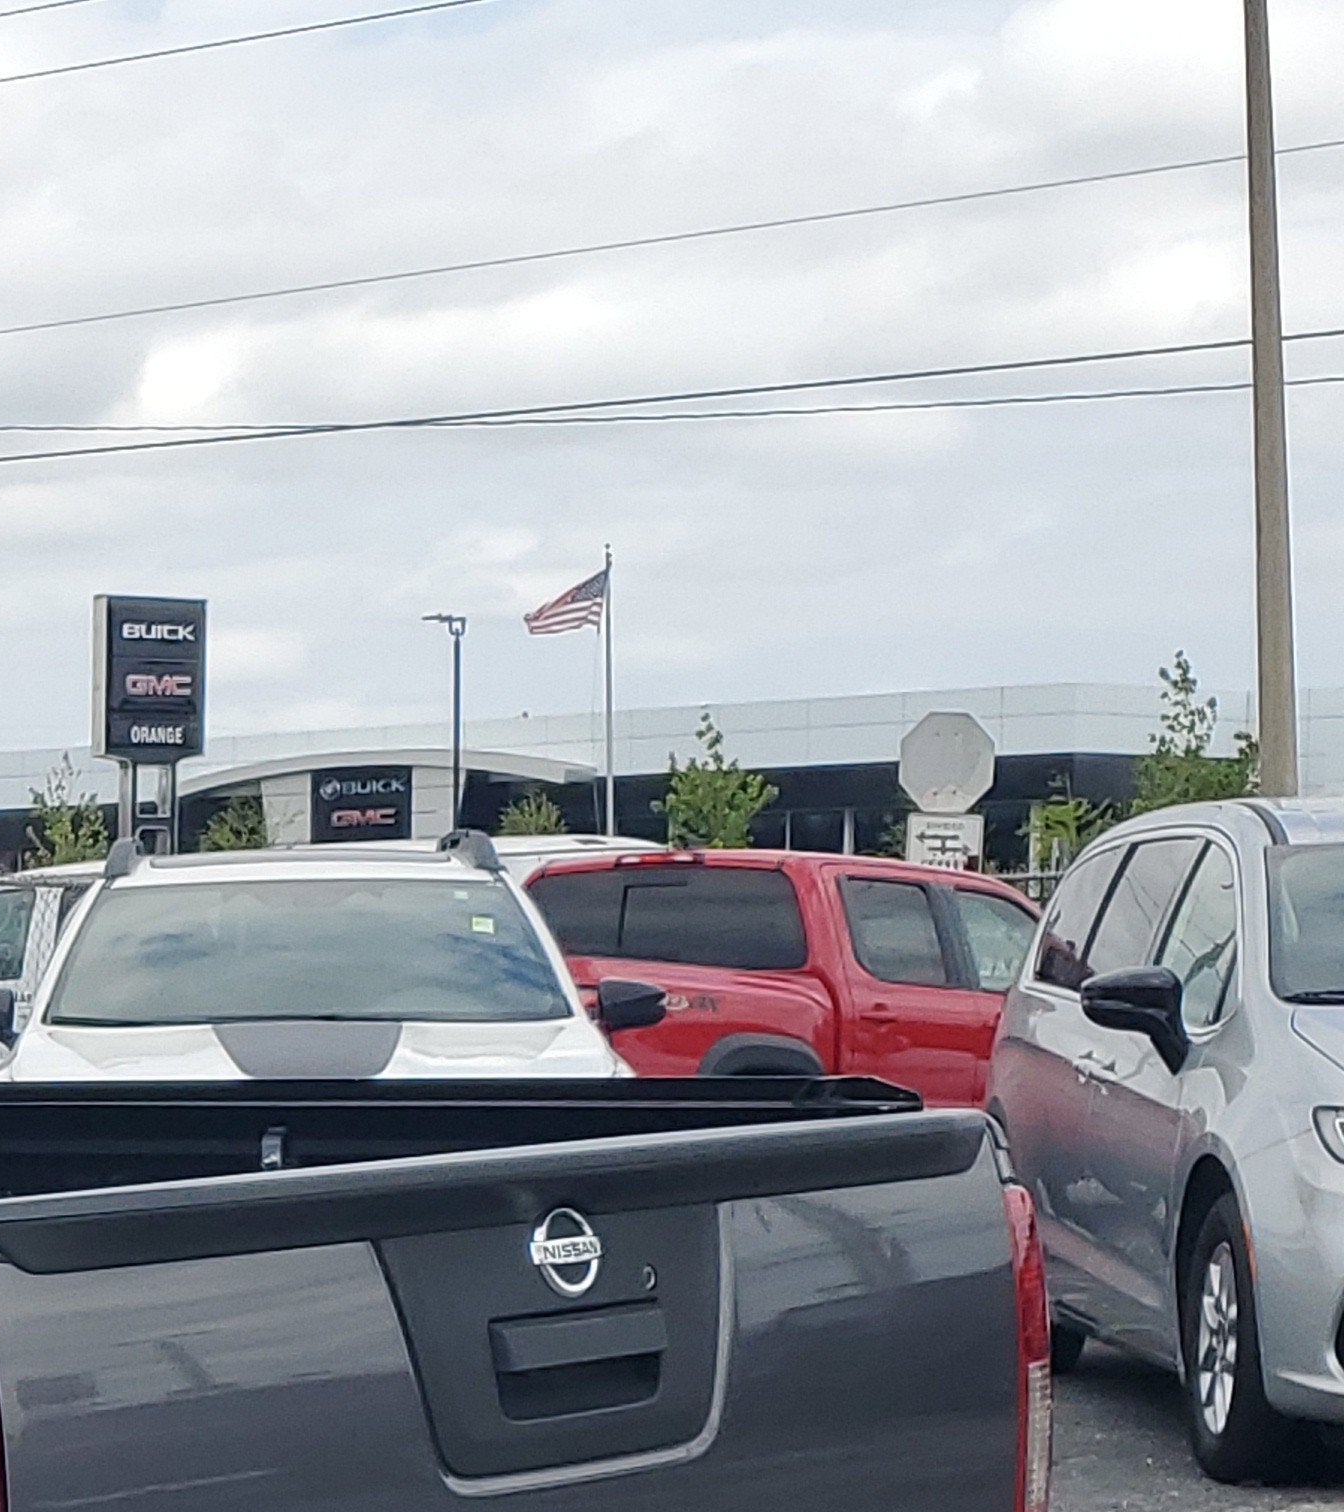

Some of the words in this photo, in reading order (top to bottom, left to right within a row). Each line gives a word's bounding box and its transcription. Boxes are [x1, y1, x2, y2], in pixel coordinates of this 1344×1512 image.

[121, 622, 196, 641] BUICK
[125, 673, 192, 696] GMC
[129, 725, 186, 744] ORANGE
[341, 777, 406, 795] BUICK
[330, 808, 397, 828] GMC
[542, 1239, 599, 1261] NISSAN
